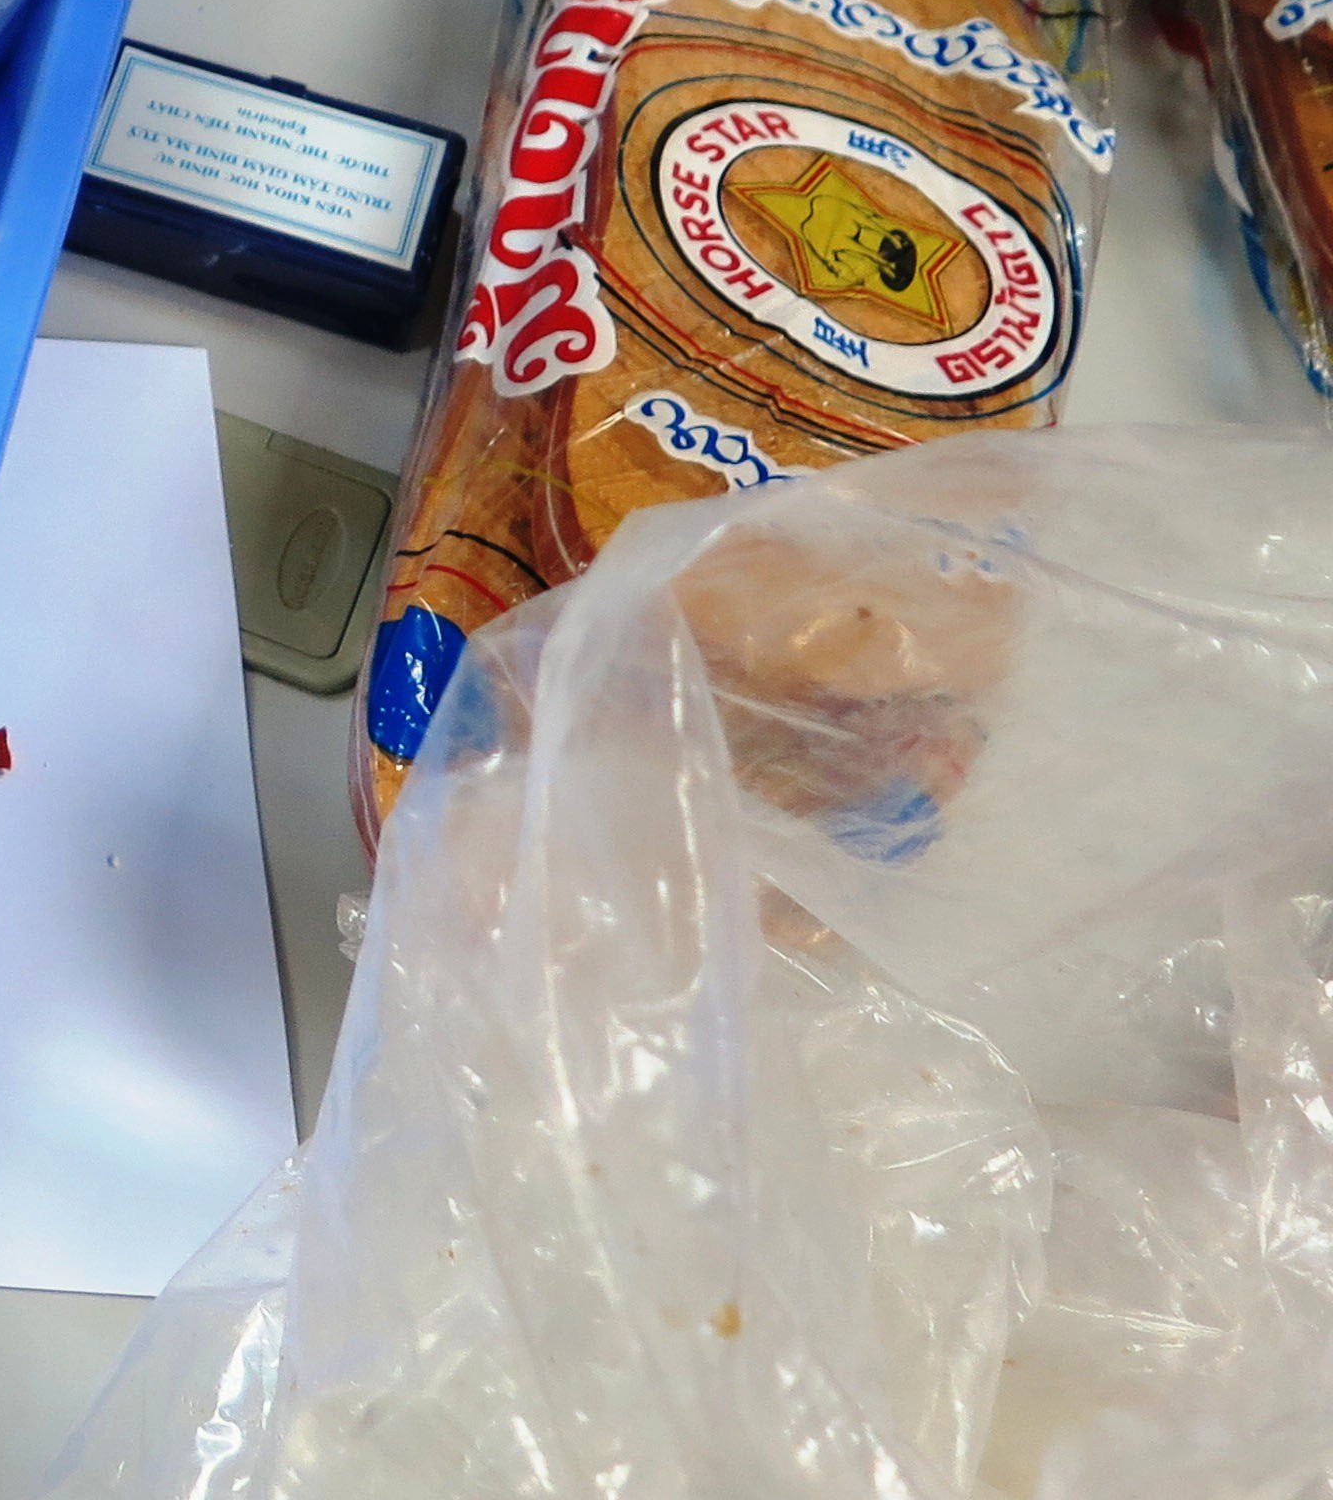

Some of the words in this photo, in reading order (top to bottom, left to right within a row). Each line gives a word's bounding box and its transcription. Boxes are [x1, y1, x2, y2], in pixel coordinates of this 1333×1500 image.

[164, 137, 191, 151] MA
[234, 125, 292, 147] NHANH
[687, 111, 798, 162] STAR
[263, 185, 310, 204] KHOA
[334, 187, 392, 210] TRUNG
[672, 162, 775, 299] HORSE
